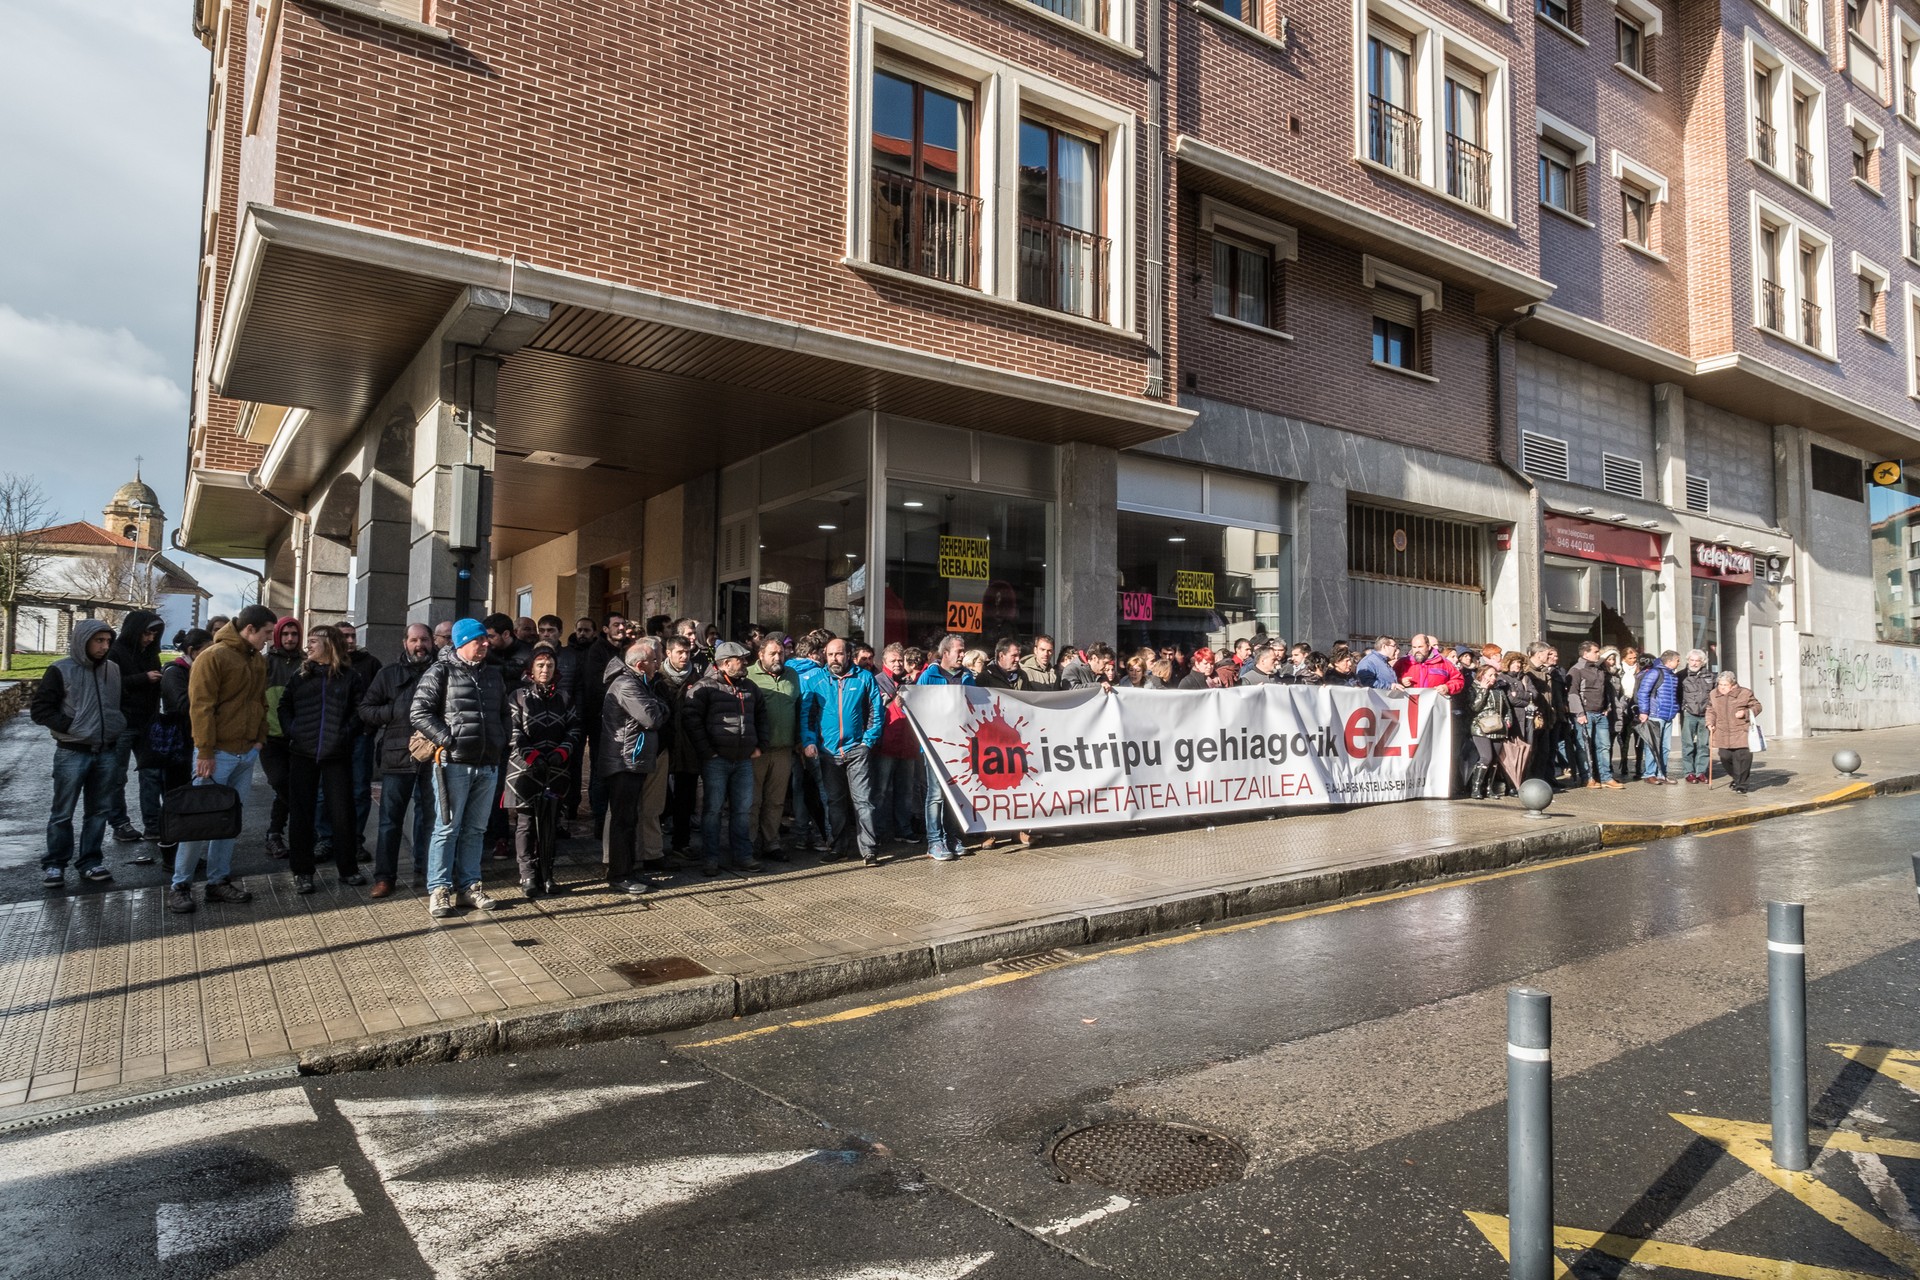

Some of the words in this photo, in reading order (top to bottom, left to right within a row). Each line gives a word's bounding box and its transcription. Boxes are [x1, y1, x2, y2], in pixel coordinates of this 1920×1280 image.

[1557, 527, 1595, 541] www.telepizza.es
[1557, 537, 1570, 549] 946
[1570, 540, 1582, 551] 440
[1583, 542, 1595, 553] 000
[940, 537, 989, 560] BEHERAPENAK
[1696, 543, 1751, 576] telepizza
[941, 558, 988, 578] REBAJAS
[1124, 593, 1151, 619] 30%
[1178, 590, 1213, 608] REBAJAS
[947, 604, 981, 630] 20%
[971, 736, 1029, 775] lan
[1040, 732, 1162, 776] istripu
[1174, 727, 1340, 772] gehiagorik
[1344, 693, 1420, 759] ez!
[972, 782, 1181, 822] PREKARIETATEA
[1185, 773, 1314, 806] HILTZAILEA
